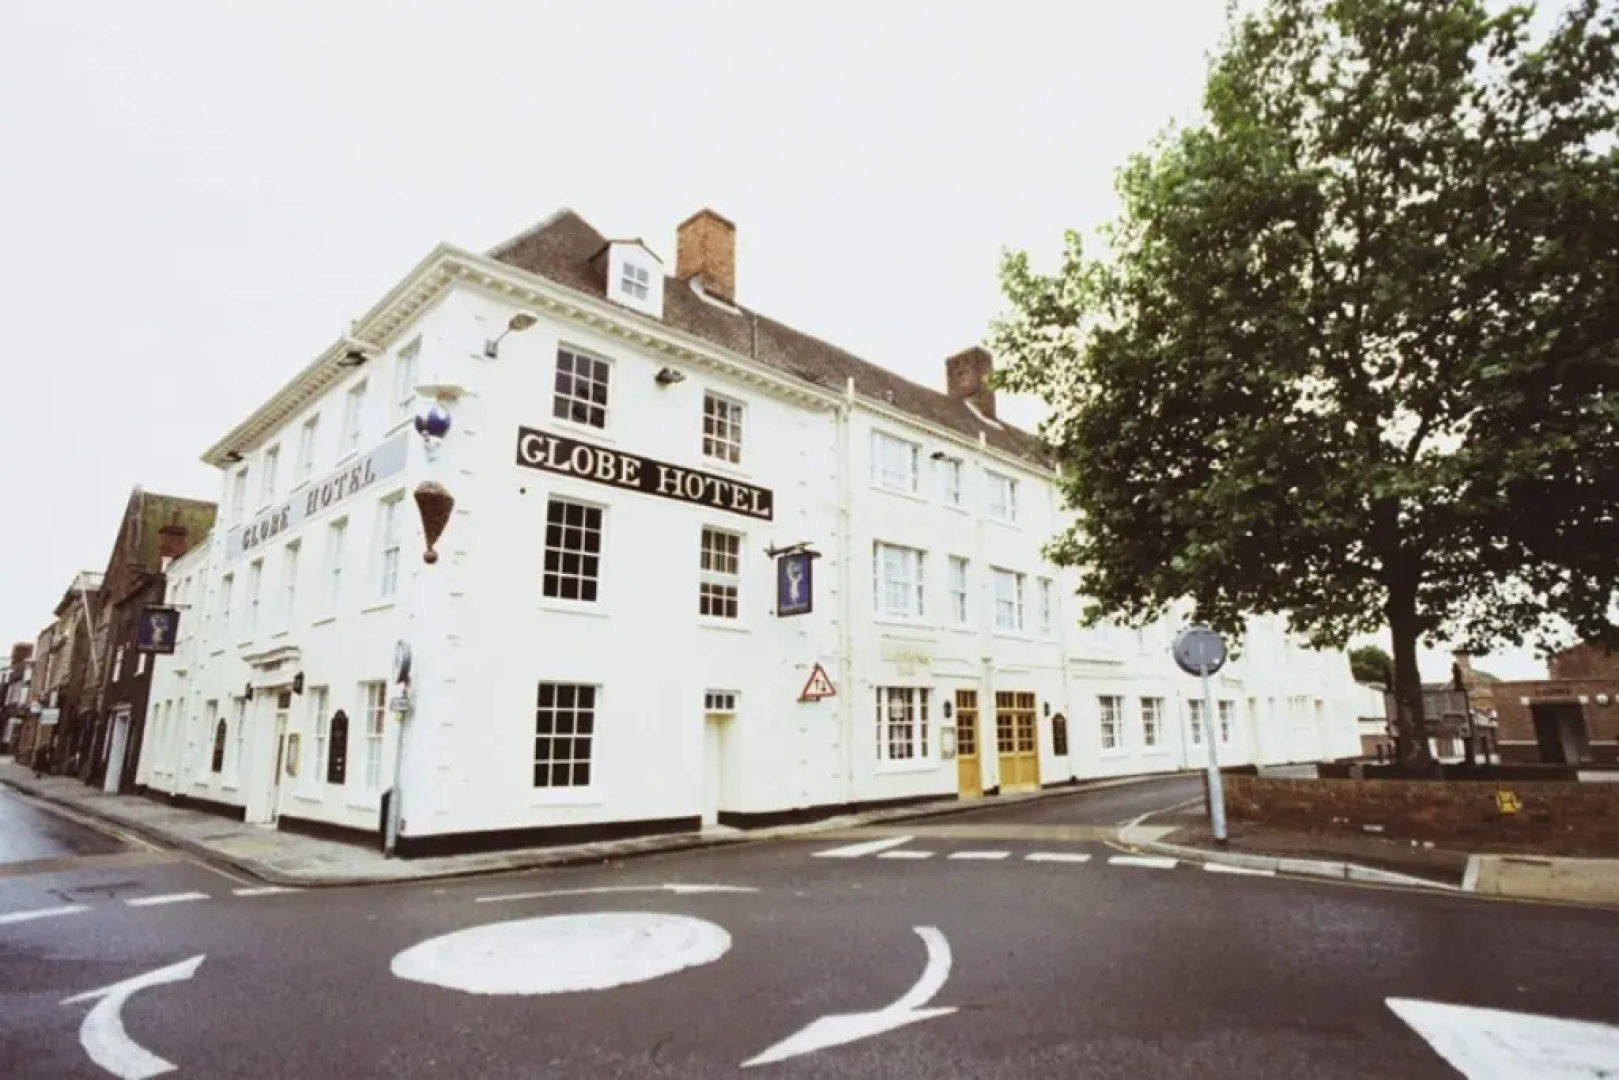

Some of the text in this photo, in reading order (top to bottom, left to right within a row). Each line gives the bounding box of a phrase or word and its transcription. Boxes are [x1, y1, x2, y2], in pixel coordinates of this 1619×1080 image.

[242, 457, 376, 551] GLOBE HOTEL
[520, 433, 769, 516] GLOBE HOTEL
